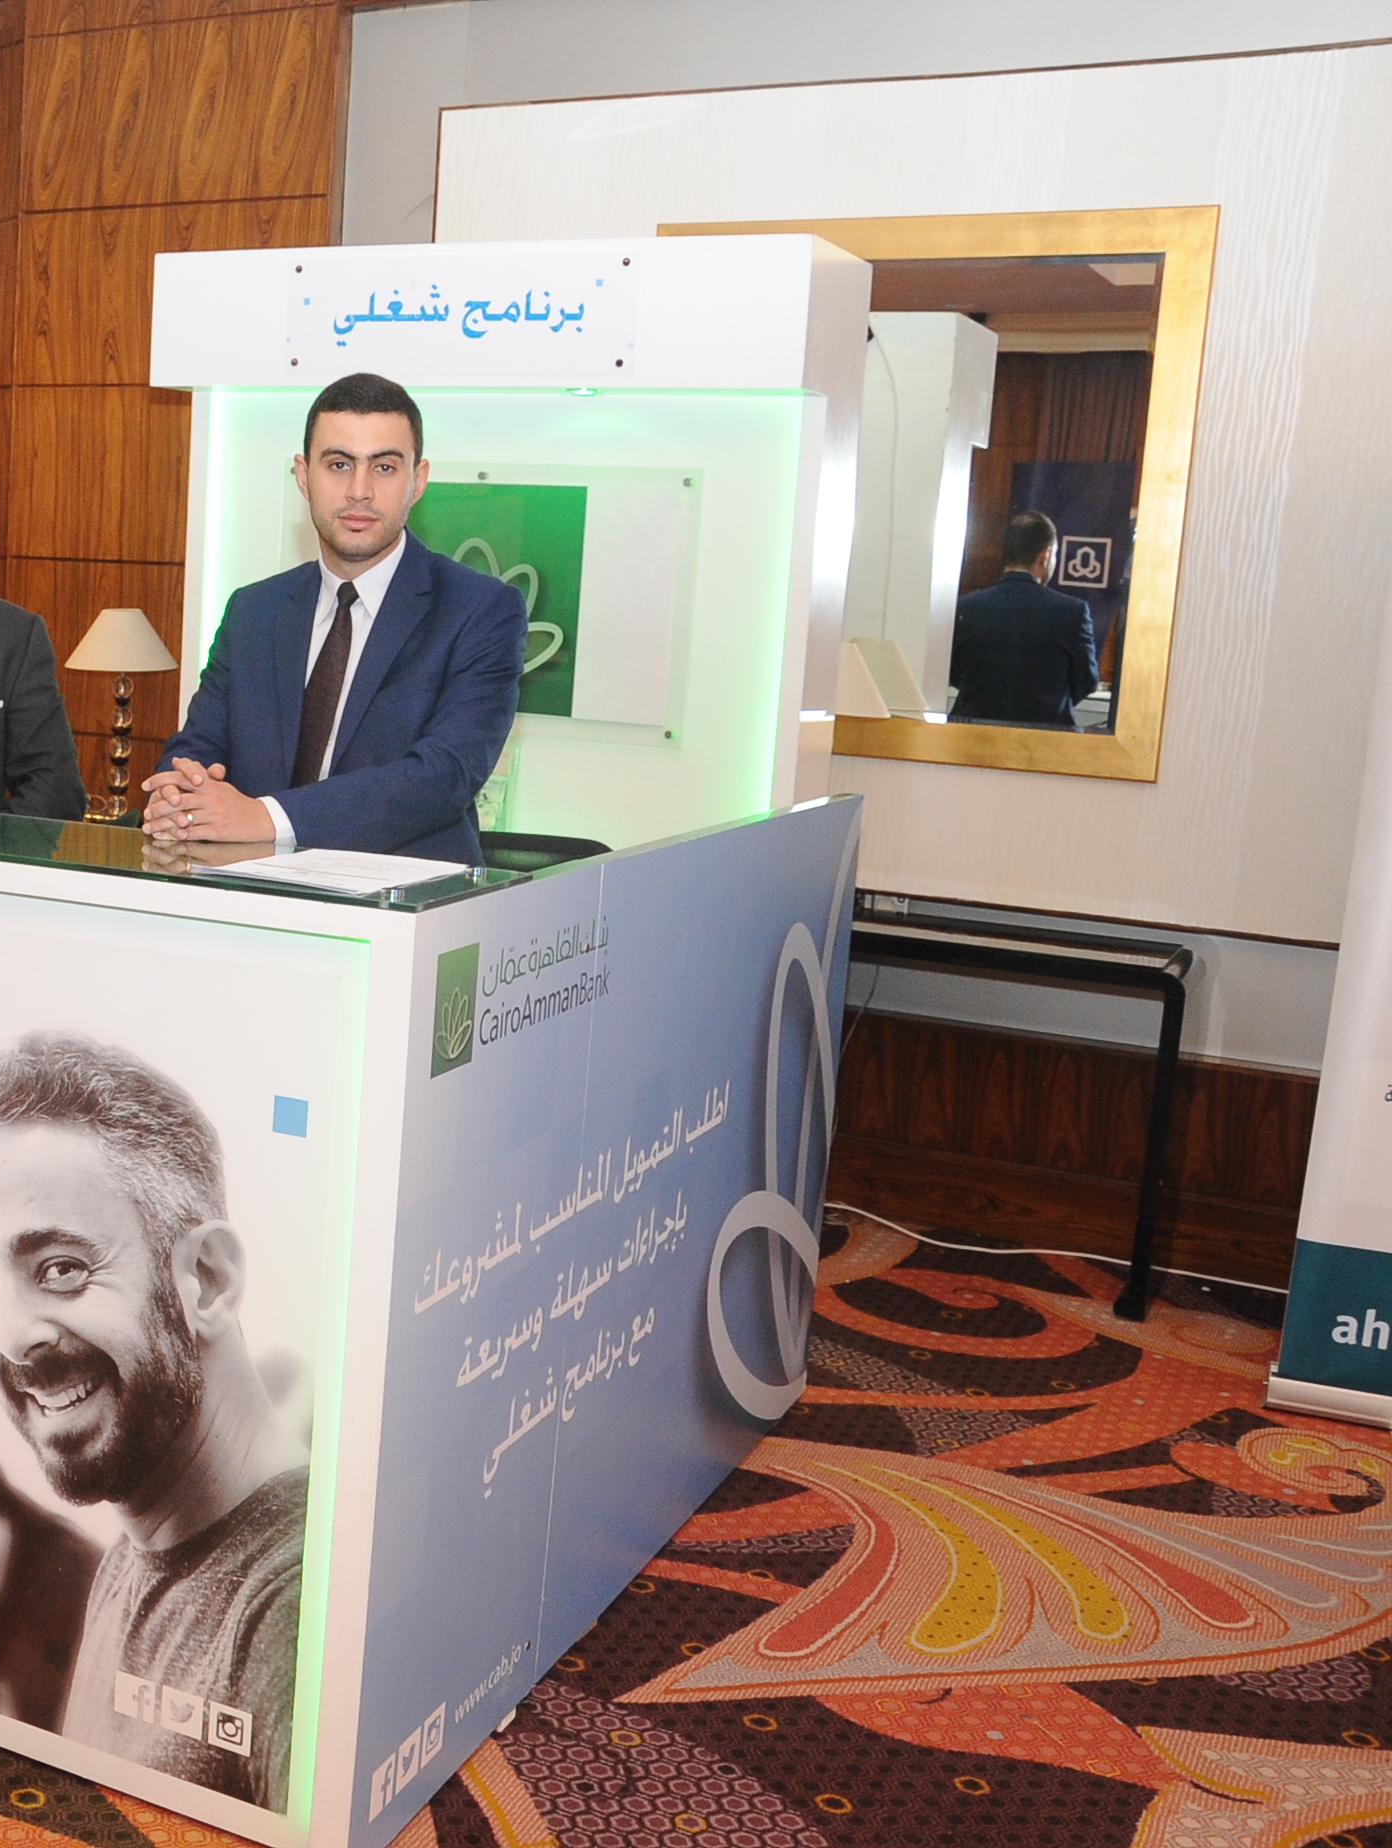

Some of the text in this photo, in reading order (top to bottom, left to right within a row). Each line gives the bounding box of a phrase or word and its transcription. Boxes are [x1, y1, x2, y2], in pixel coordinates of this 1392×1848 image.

[333, 283, 585, 347] برنامج شغلي
[528, 923, 580, 980] القاهرة
[479, 965, 611, 1046] CairoAmmanBank
[413, 1079, 731, 1315] اطلب التمويل المناسب لمشروعك
[456, 1190, 689, 1389] بإجراءات سهلة وسريعة
[482, 1306, 656, 1499] مع برنامج شغلي
[453, 1644, 522, 1725] www.cab.jo
